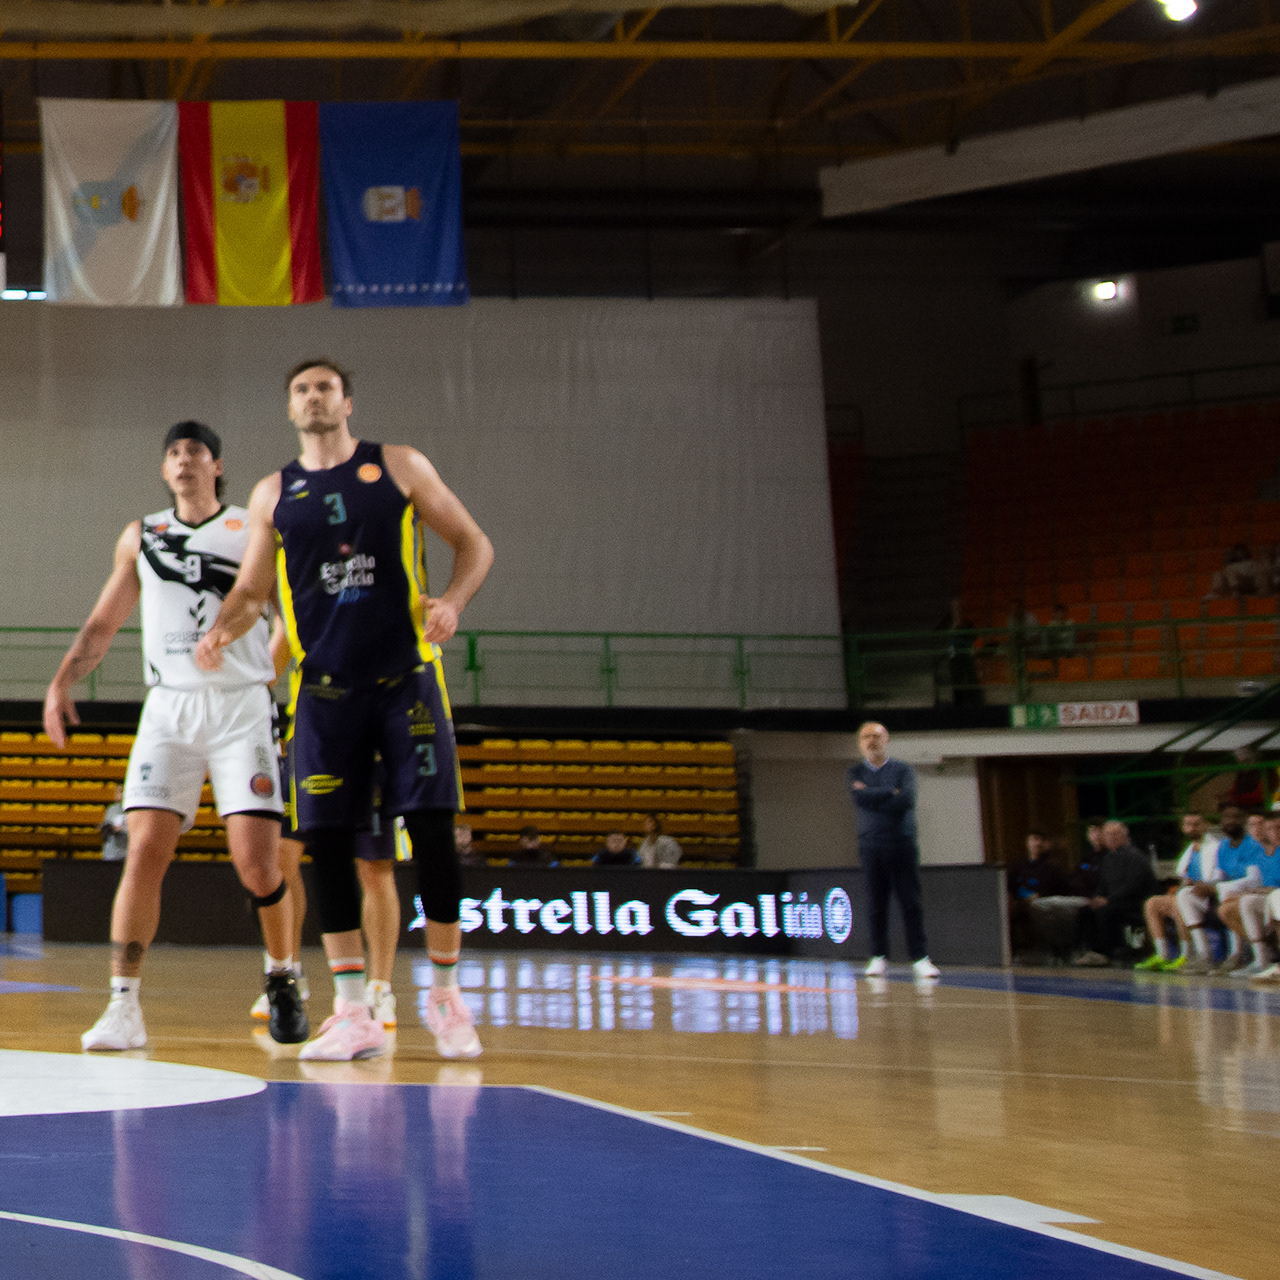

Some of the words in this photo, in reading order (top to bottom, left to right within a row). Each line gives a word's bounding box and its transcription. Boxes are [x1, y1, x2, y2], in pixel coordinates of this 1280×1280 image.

[324, 492, 347, 525] 3
[185, 555, 202, 584] 9
[415, 743, 438, 776] 3
